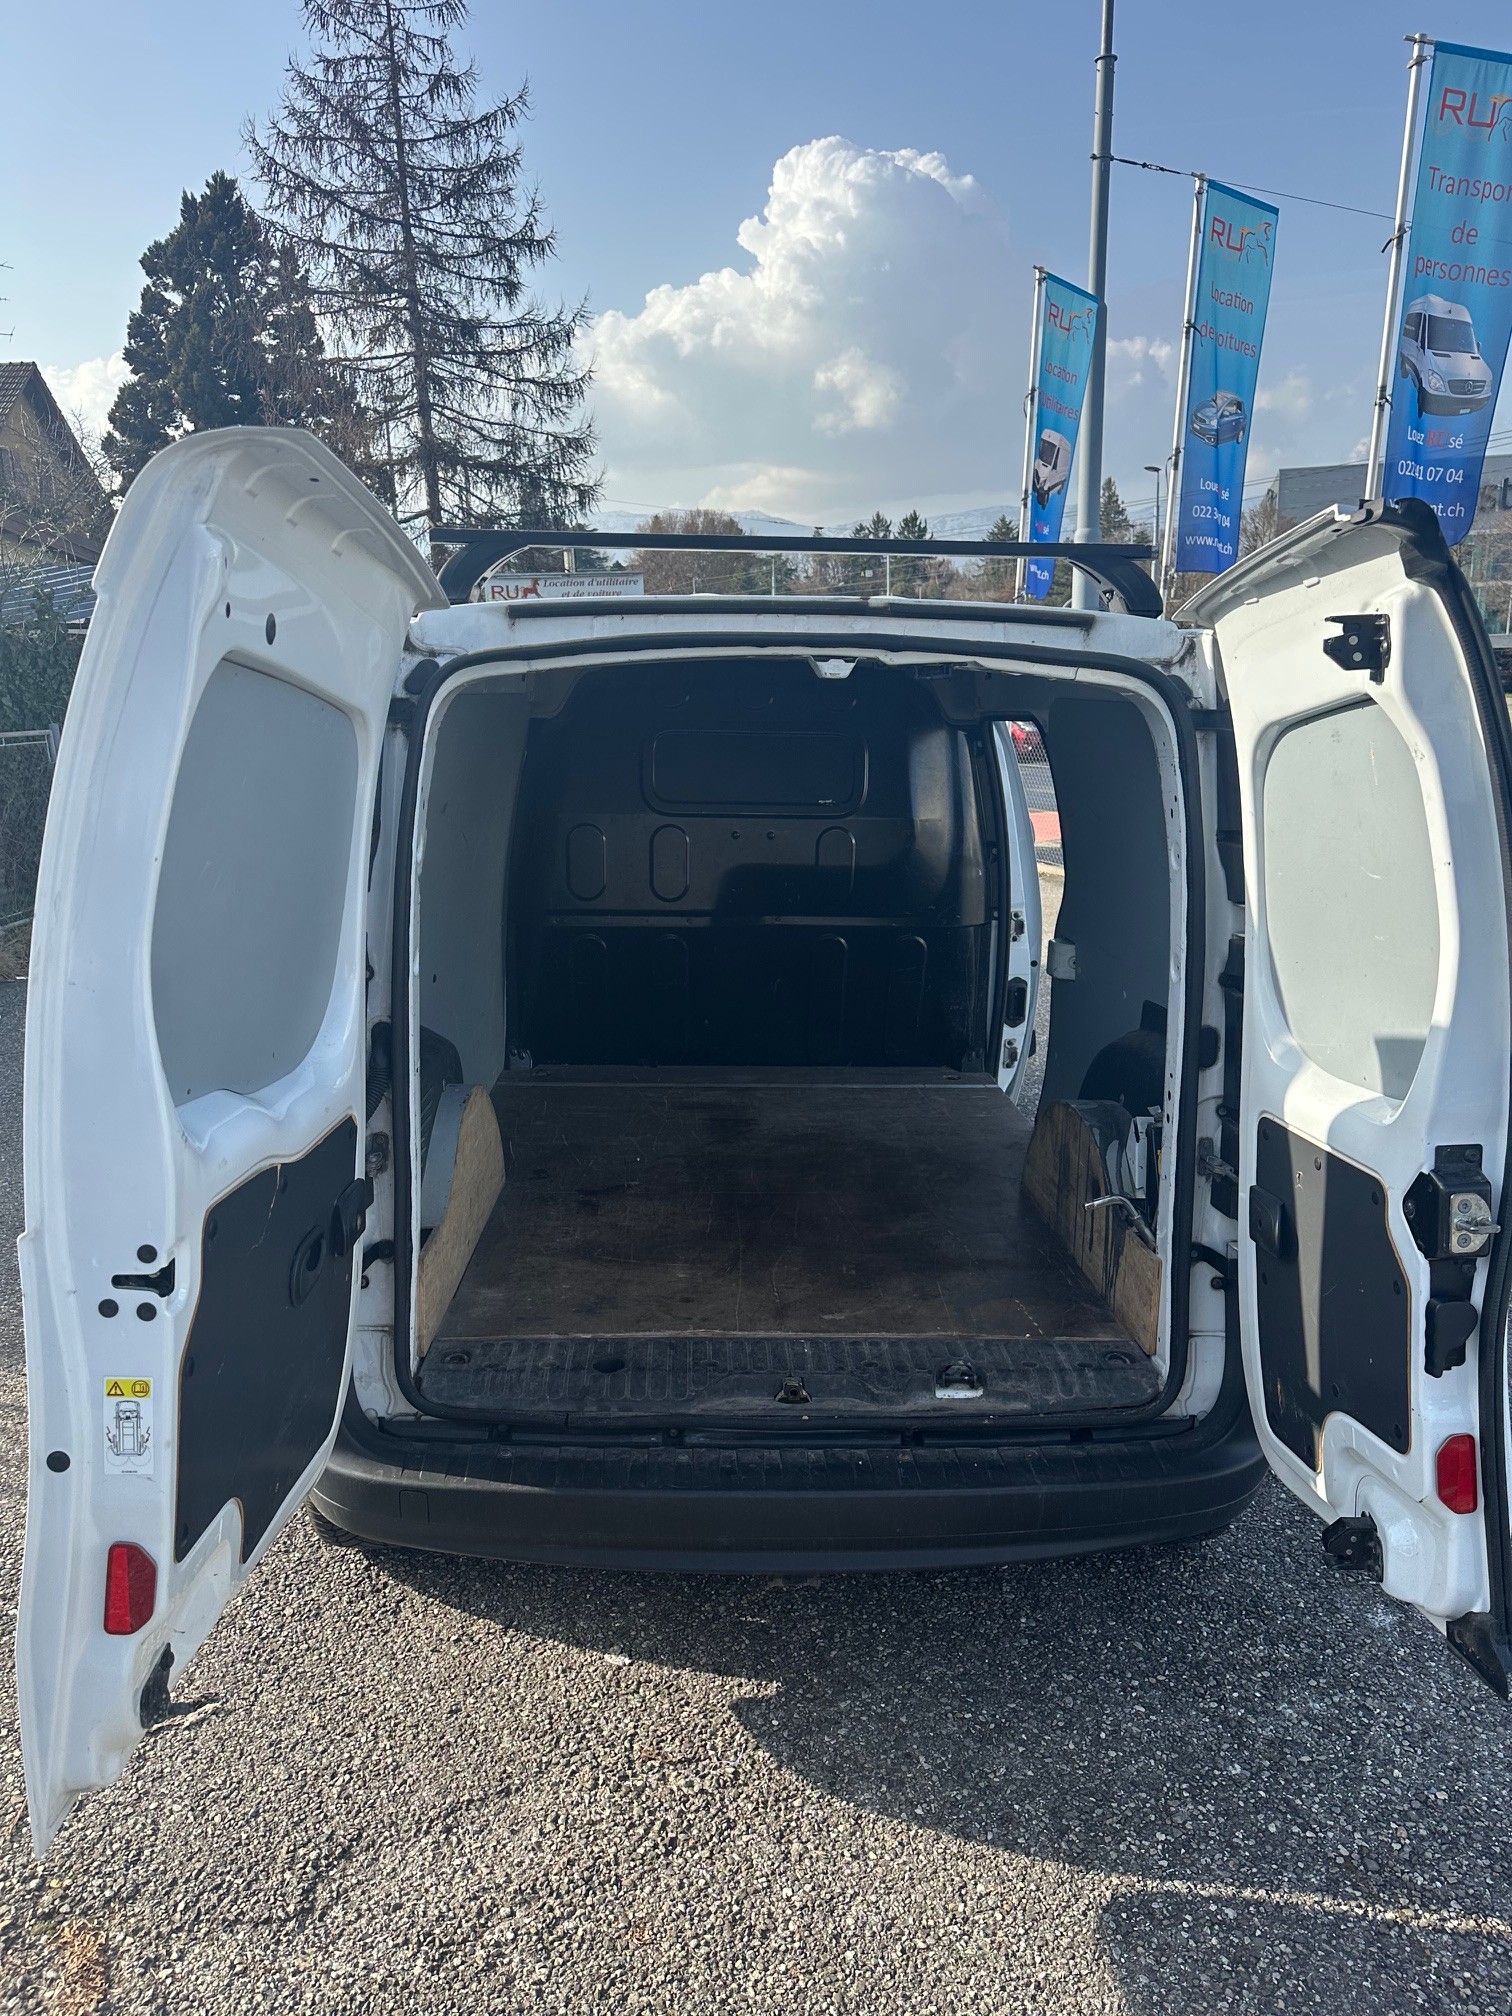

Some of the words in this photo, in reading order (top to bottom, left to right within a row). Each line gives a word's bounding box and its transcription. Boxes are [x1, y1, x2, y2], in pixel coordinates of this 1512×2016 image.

[1451, 220, 1478, 245] de
[1415, 255, 1511, 287] personnes
[1211, 281, 1254, 315] Location
[1200, 320, 1215, 340] de
[1045, 357, 1078, 386] Location
[1426, 466, 1444, 482] 07
[1446, 468, 1464, 484] 04
[1192, 505, 1212, 519] 022
[543, 579, 585, 588] Location
[561, 590, 571, 598] et
[587, 589, 622, 597] voiture
